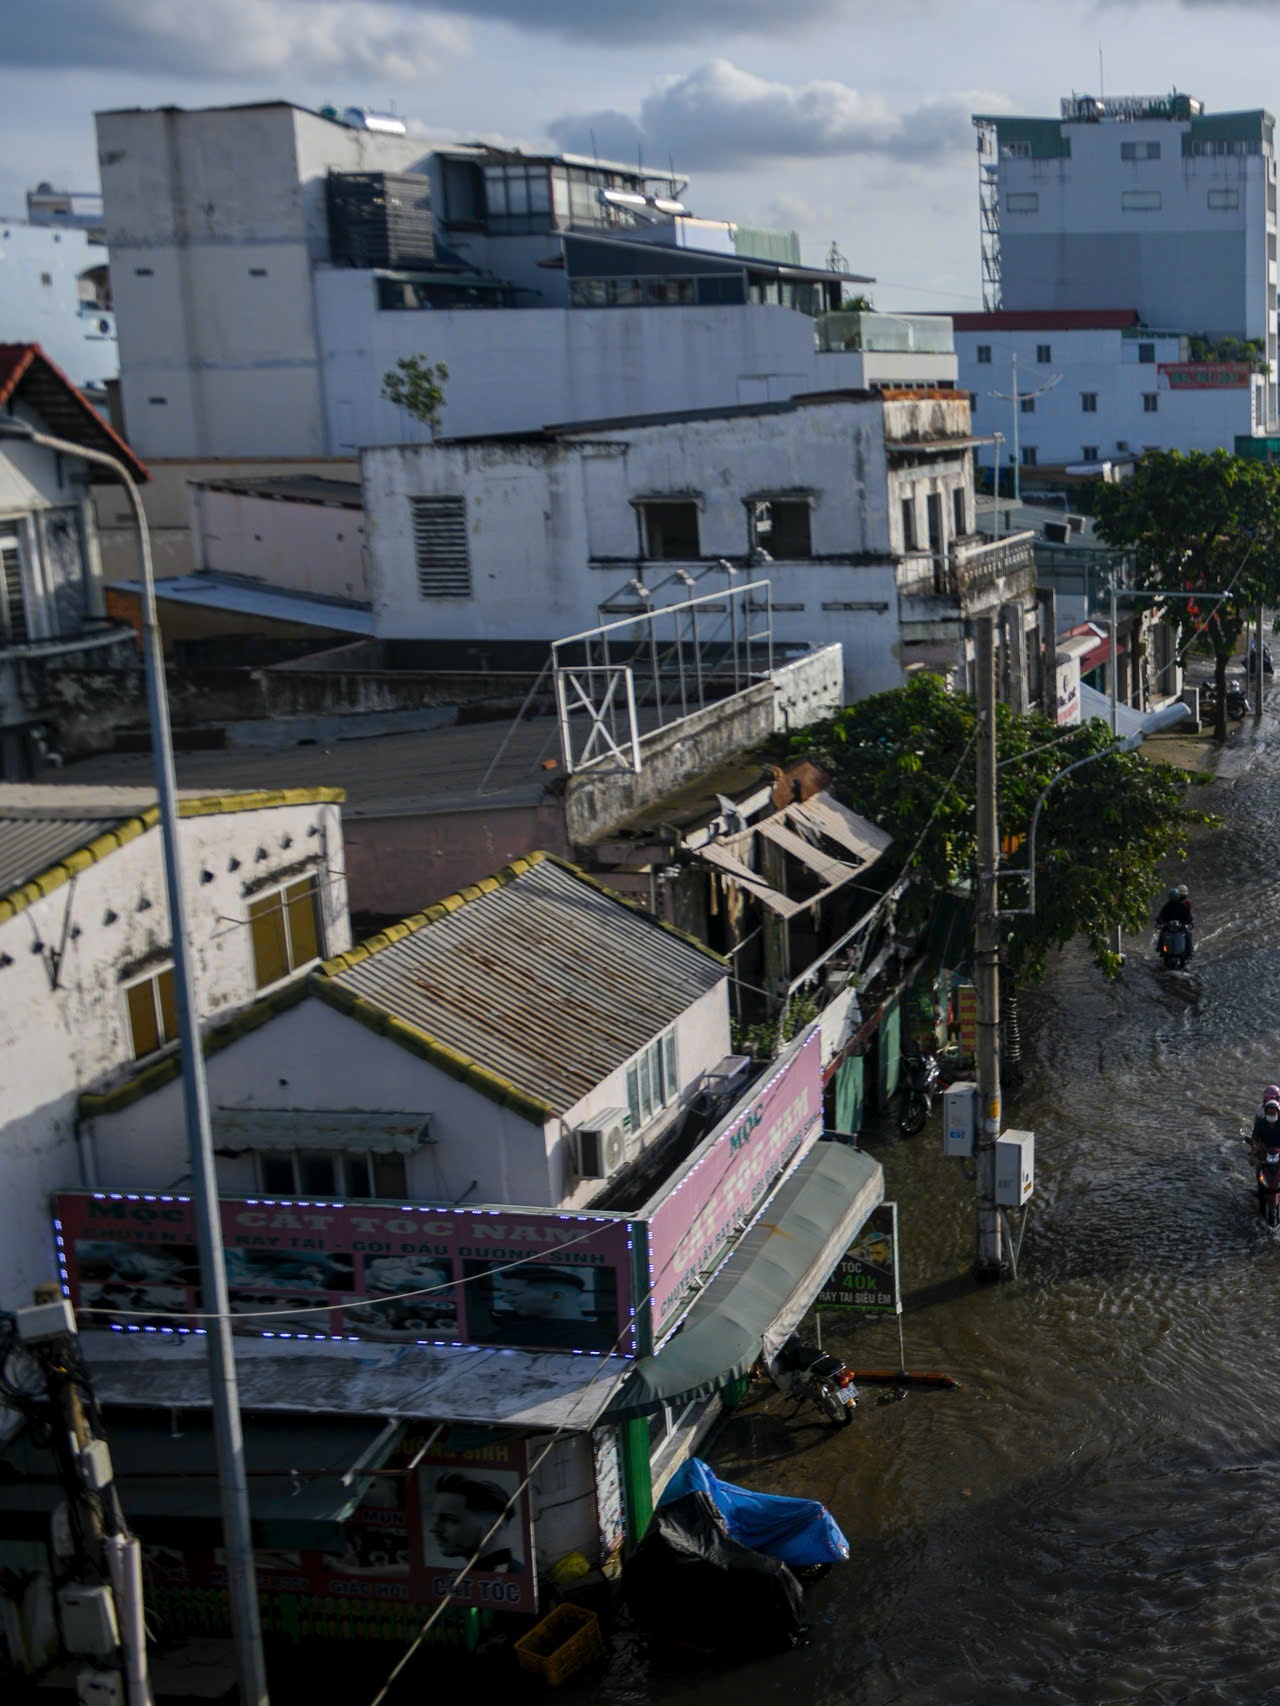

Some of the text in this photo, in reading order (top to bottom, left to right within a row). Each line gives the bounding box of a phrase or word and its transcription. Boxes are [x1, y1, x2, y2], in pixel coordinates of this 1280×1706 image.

[768, 1086, 808, 1158] NAM
[471, 1223, 592, 1244] NAM
[549, 1251, 606, 1264] SINH
[839, 1291, 854, 1303] TAI
[479, 1576, 521, 1605] TÓC
